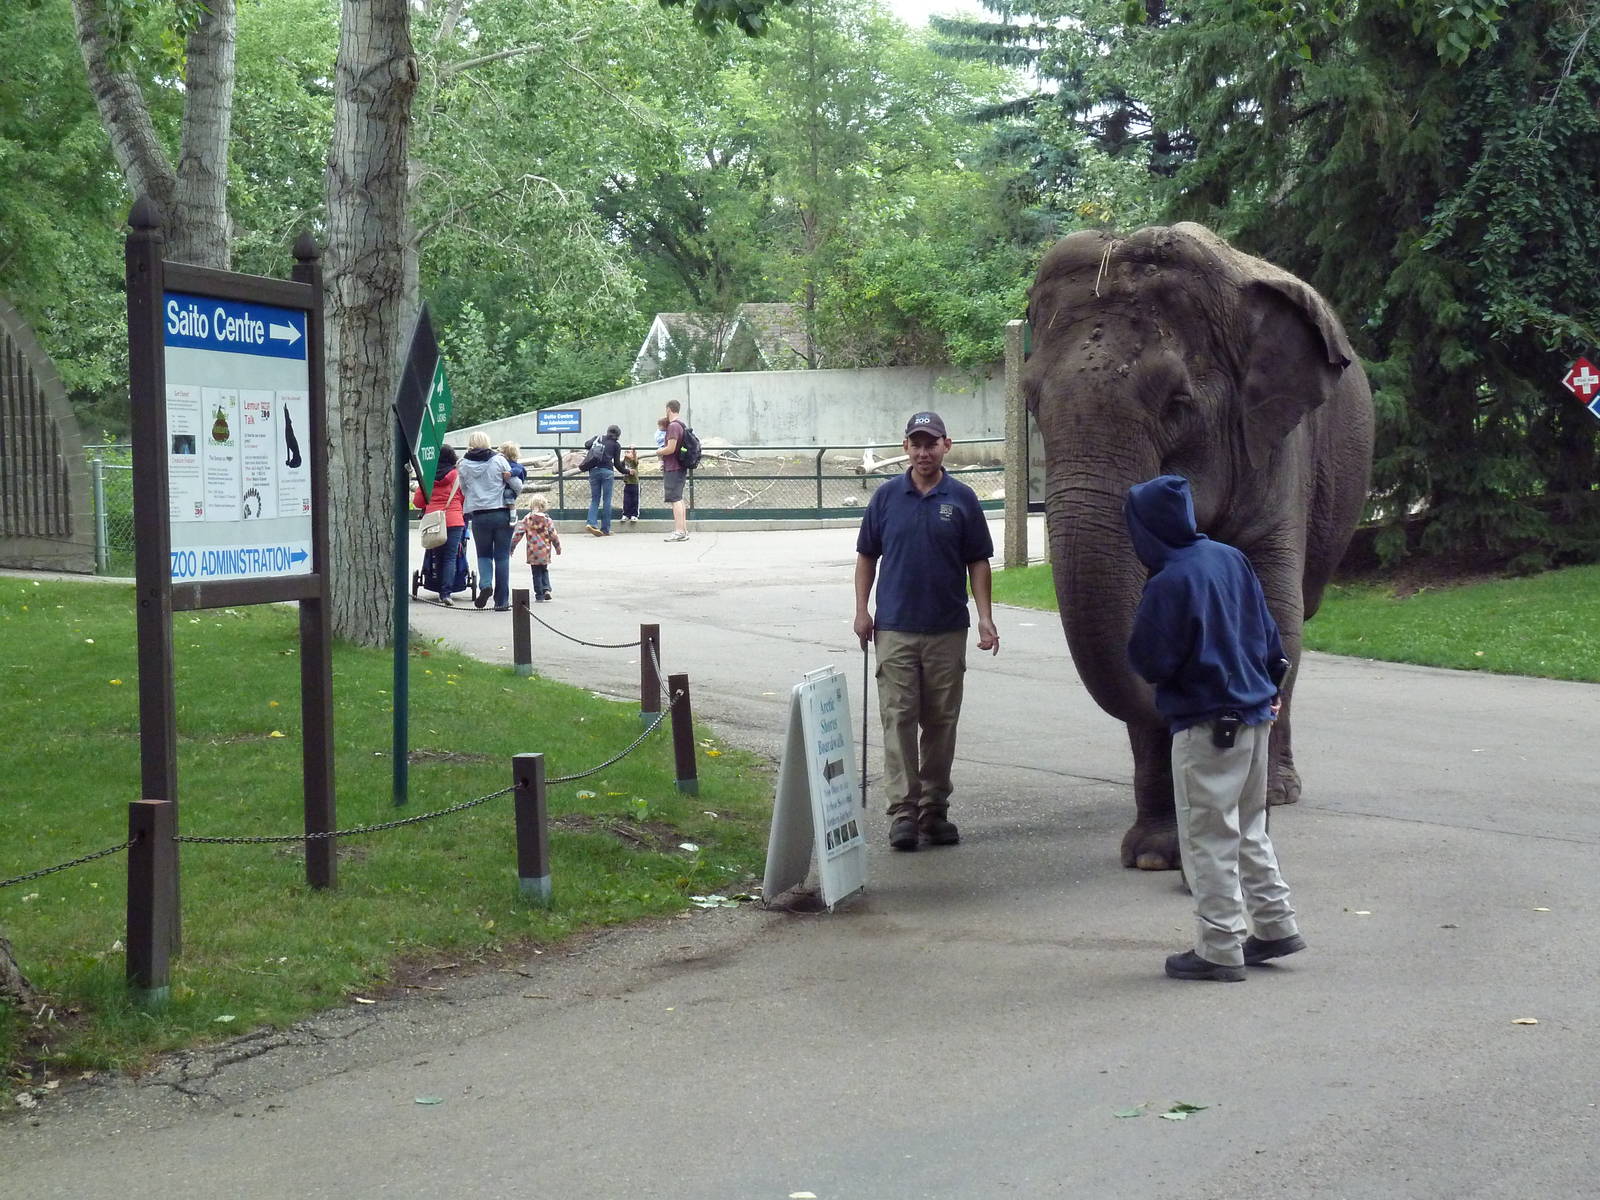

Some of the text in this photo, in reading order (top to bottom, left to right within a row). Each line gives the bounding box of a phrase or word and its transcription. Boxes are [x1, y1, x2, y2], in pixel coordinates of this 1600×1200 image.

[167, 300, 265, 345] Saito Centre
[438, 403, 446, 412] SEA
[421, 446, 436, 461] TIGER
[170, 546, 291, 578] ZOO ADMINISTRATION
